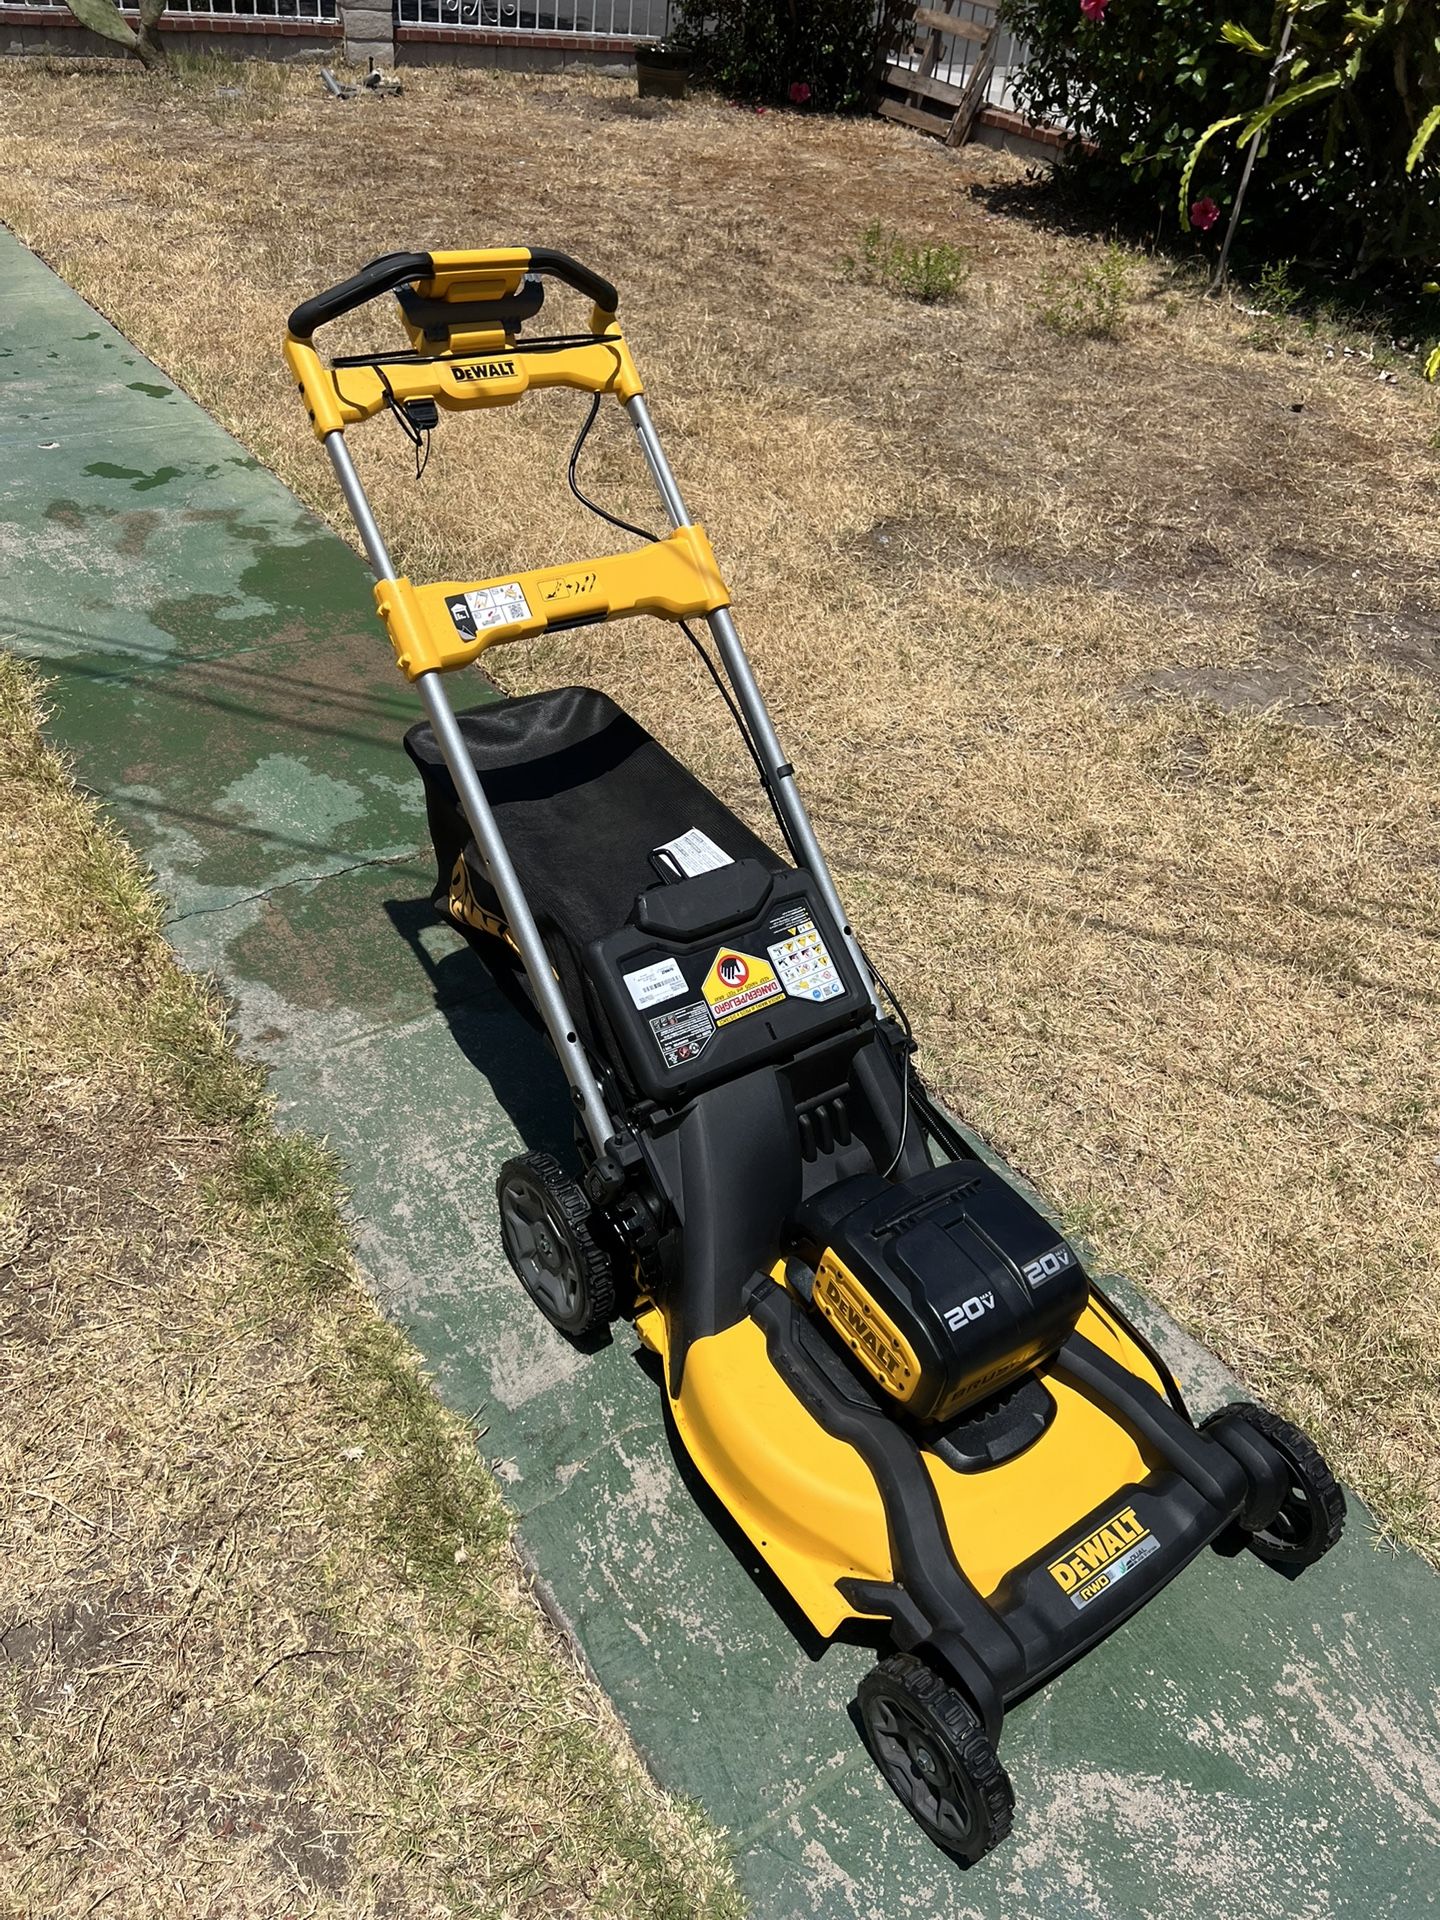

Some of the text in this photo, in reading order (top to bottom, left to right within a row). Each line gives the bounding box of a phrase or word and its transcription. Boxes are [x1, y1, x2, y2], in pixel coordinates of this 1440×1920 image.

[451, 362, 515, 381] DEWALT
[826, 1280, 900, 1374] DEWALT
[1049, 1508, 1145, 1592] DEWALT
[1130, 1547, 1148, 1561] DUAL
[1080, 1574, 1110, 1601] RWD
